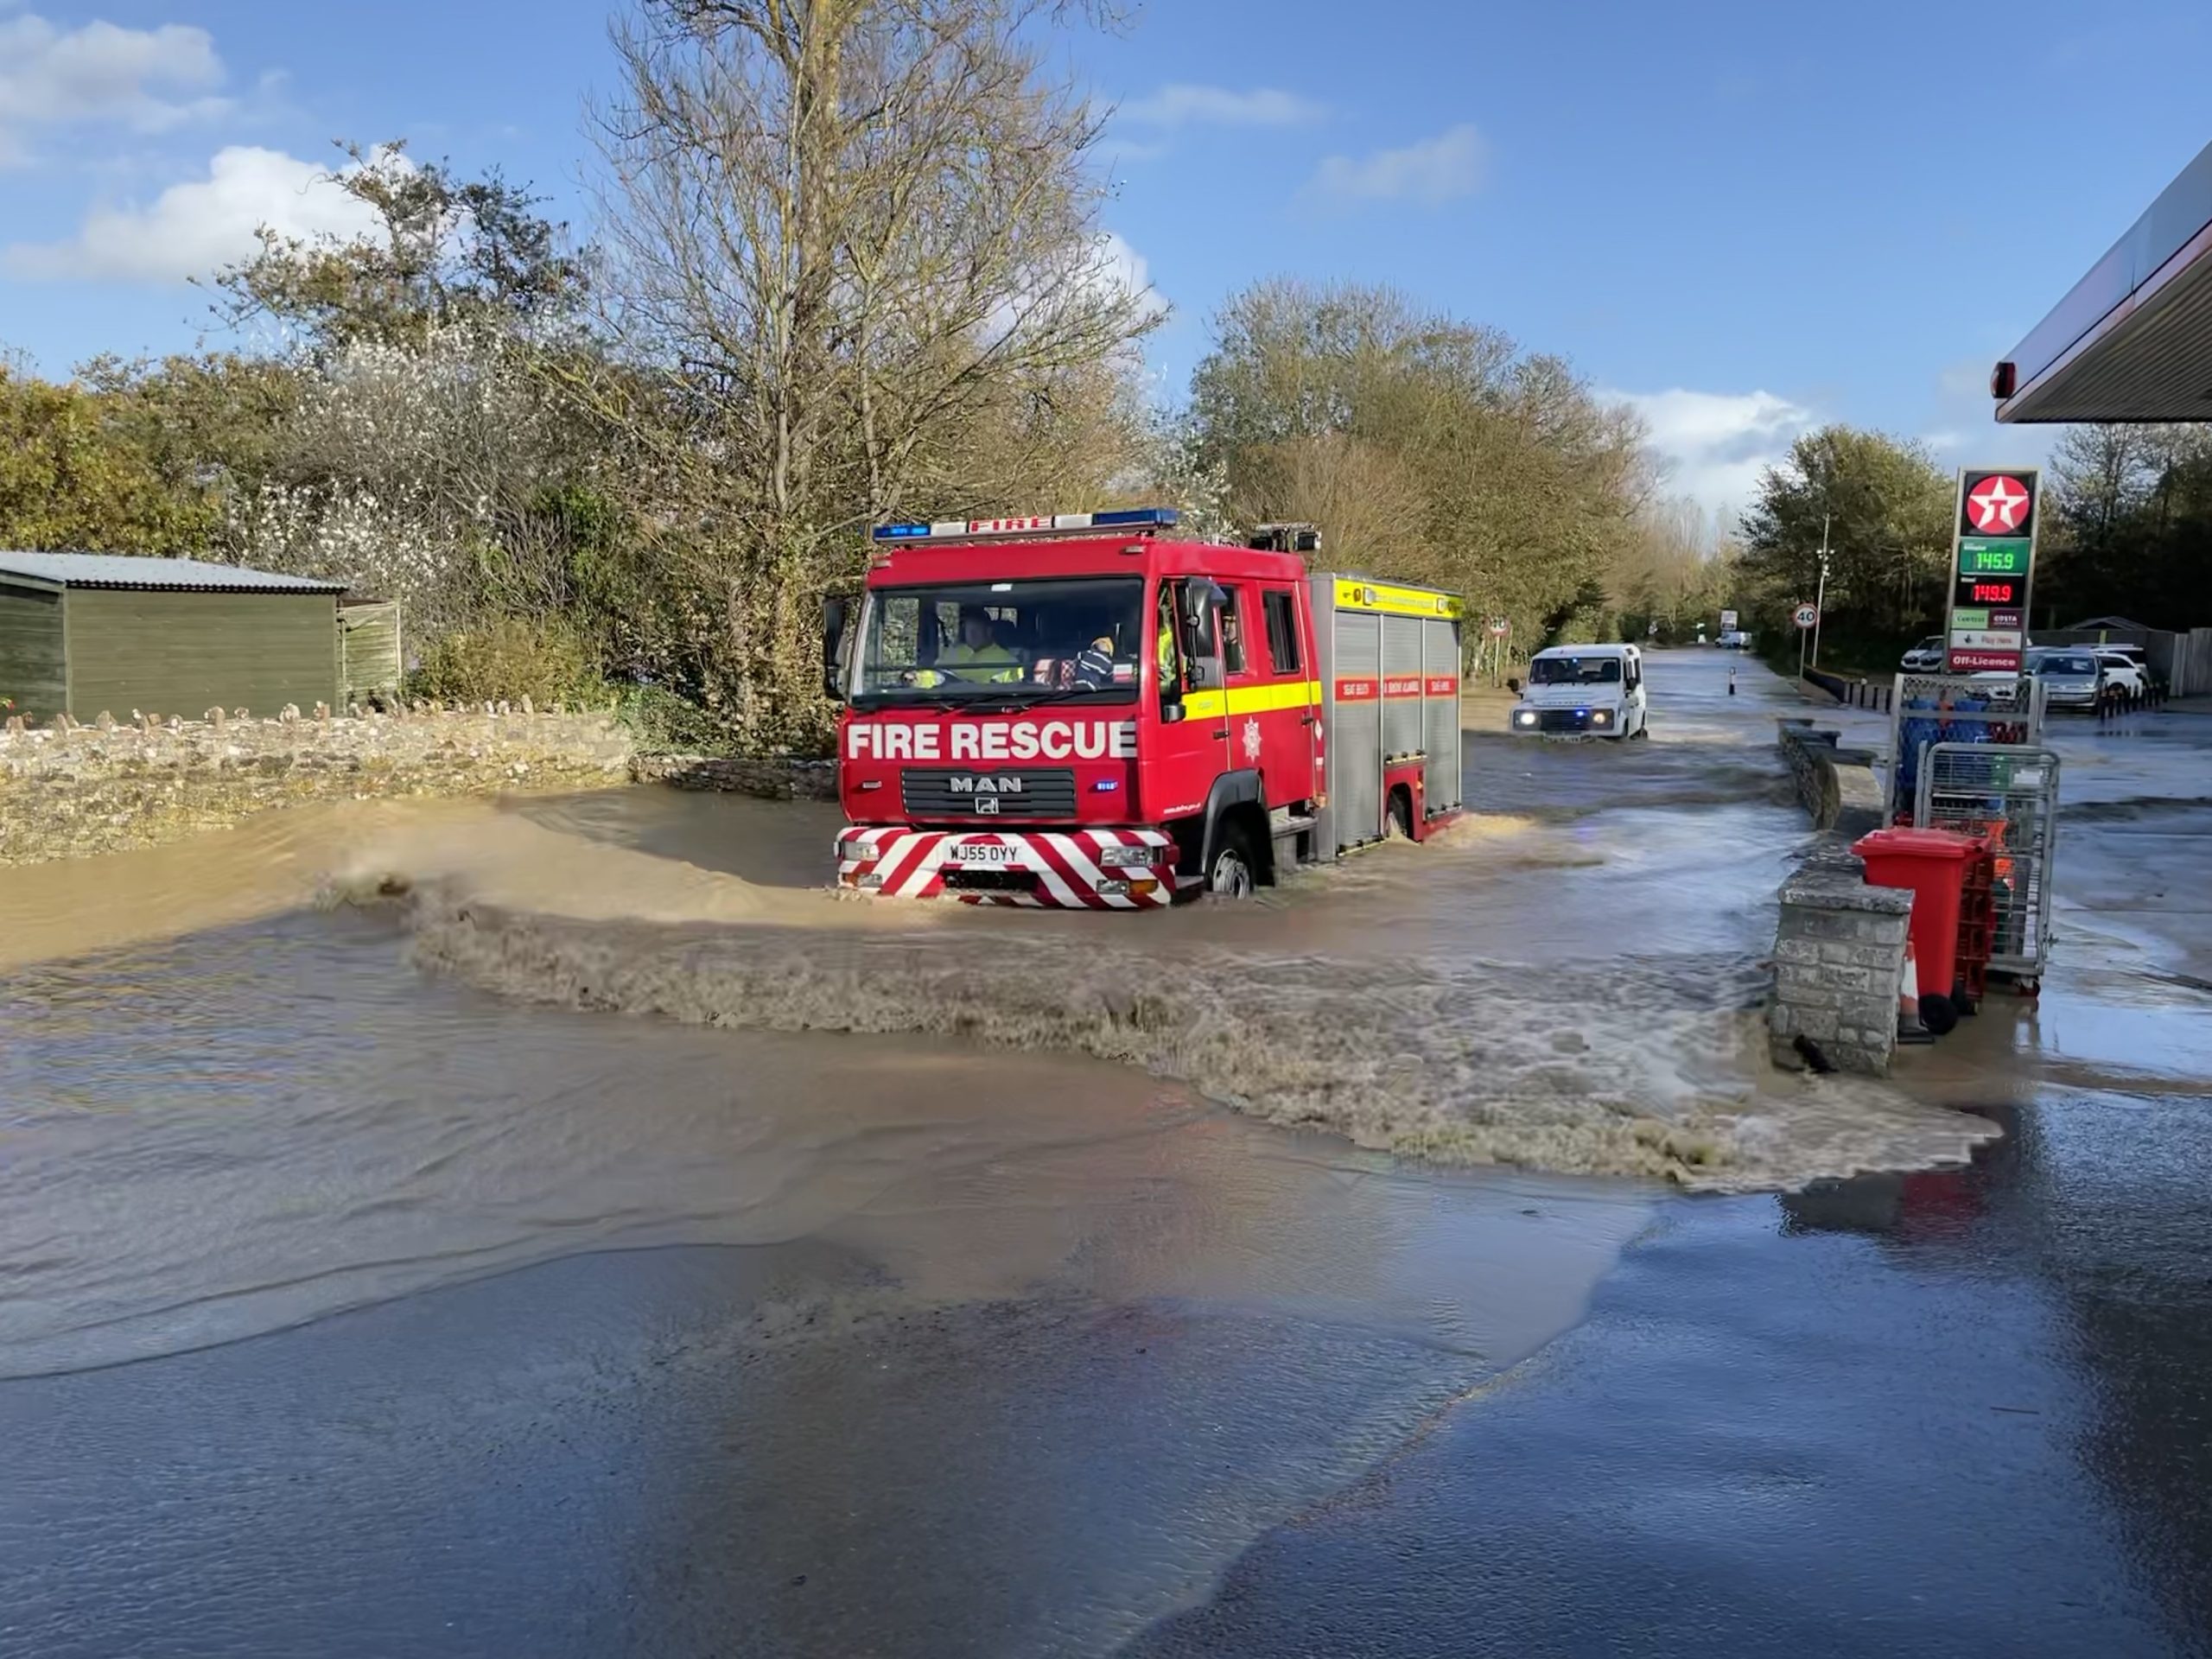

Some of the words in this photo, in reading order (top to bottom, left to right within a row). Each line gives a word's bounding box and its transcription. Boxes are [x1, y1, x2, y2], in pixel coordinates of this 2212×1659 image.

[970, 516, 1050, 532] FIRE
[1977, 553, 2014, 569] 145.9
[1974, 585, 2012, 601] 149.9
[1797, 612, 1815, 622] 40
[1953, 655, 2017, 666] Off-Licence
[848, 723, 941, 760] FIRE
[951, 721, 1137, 760] RESCUE
[950, 777, 1021, 792] MAN
[950, 845, 986, 861] WJ55
[990, 846, 1017, 861] OYY
